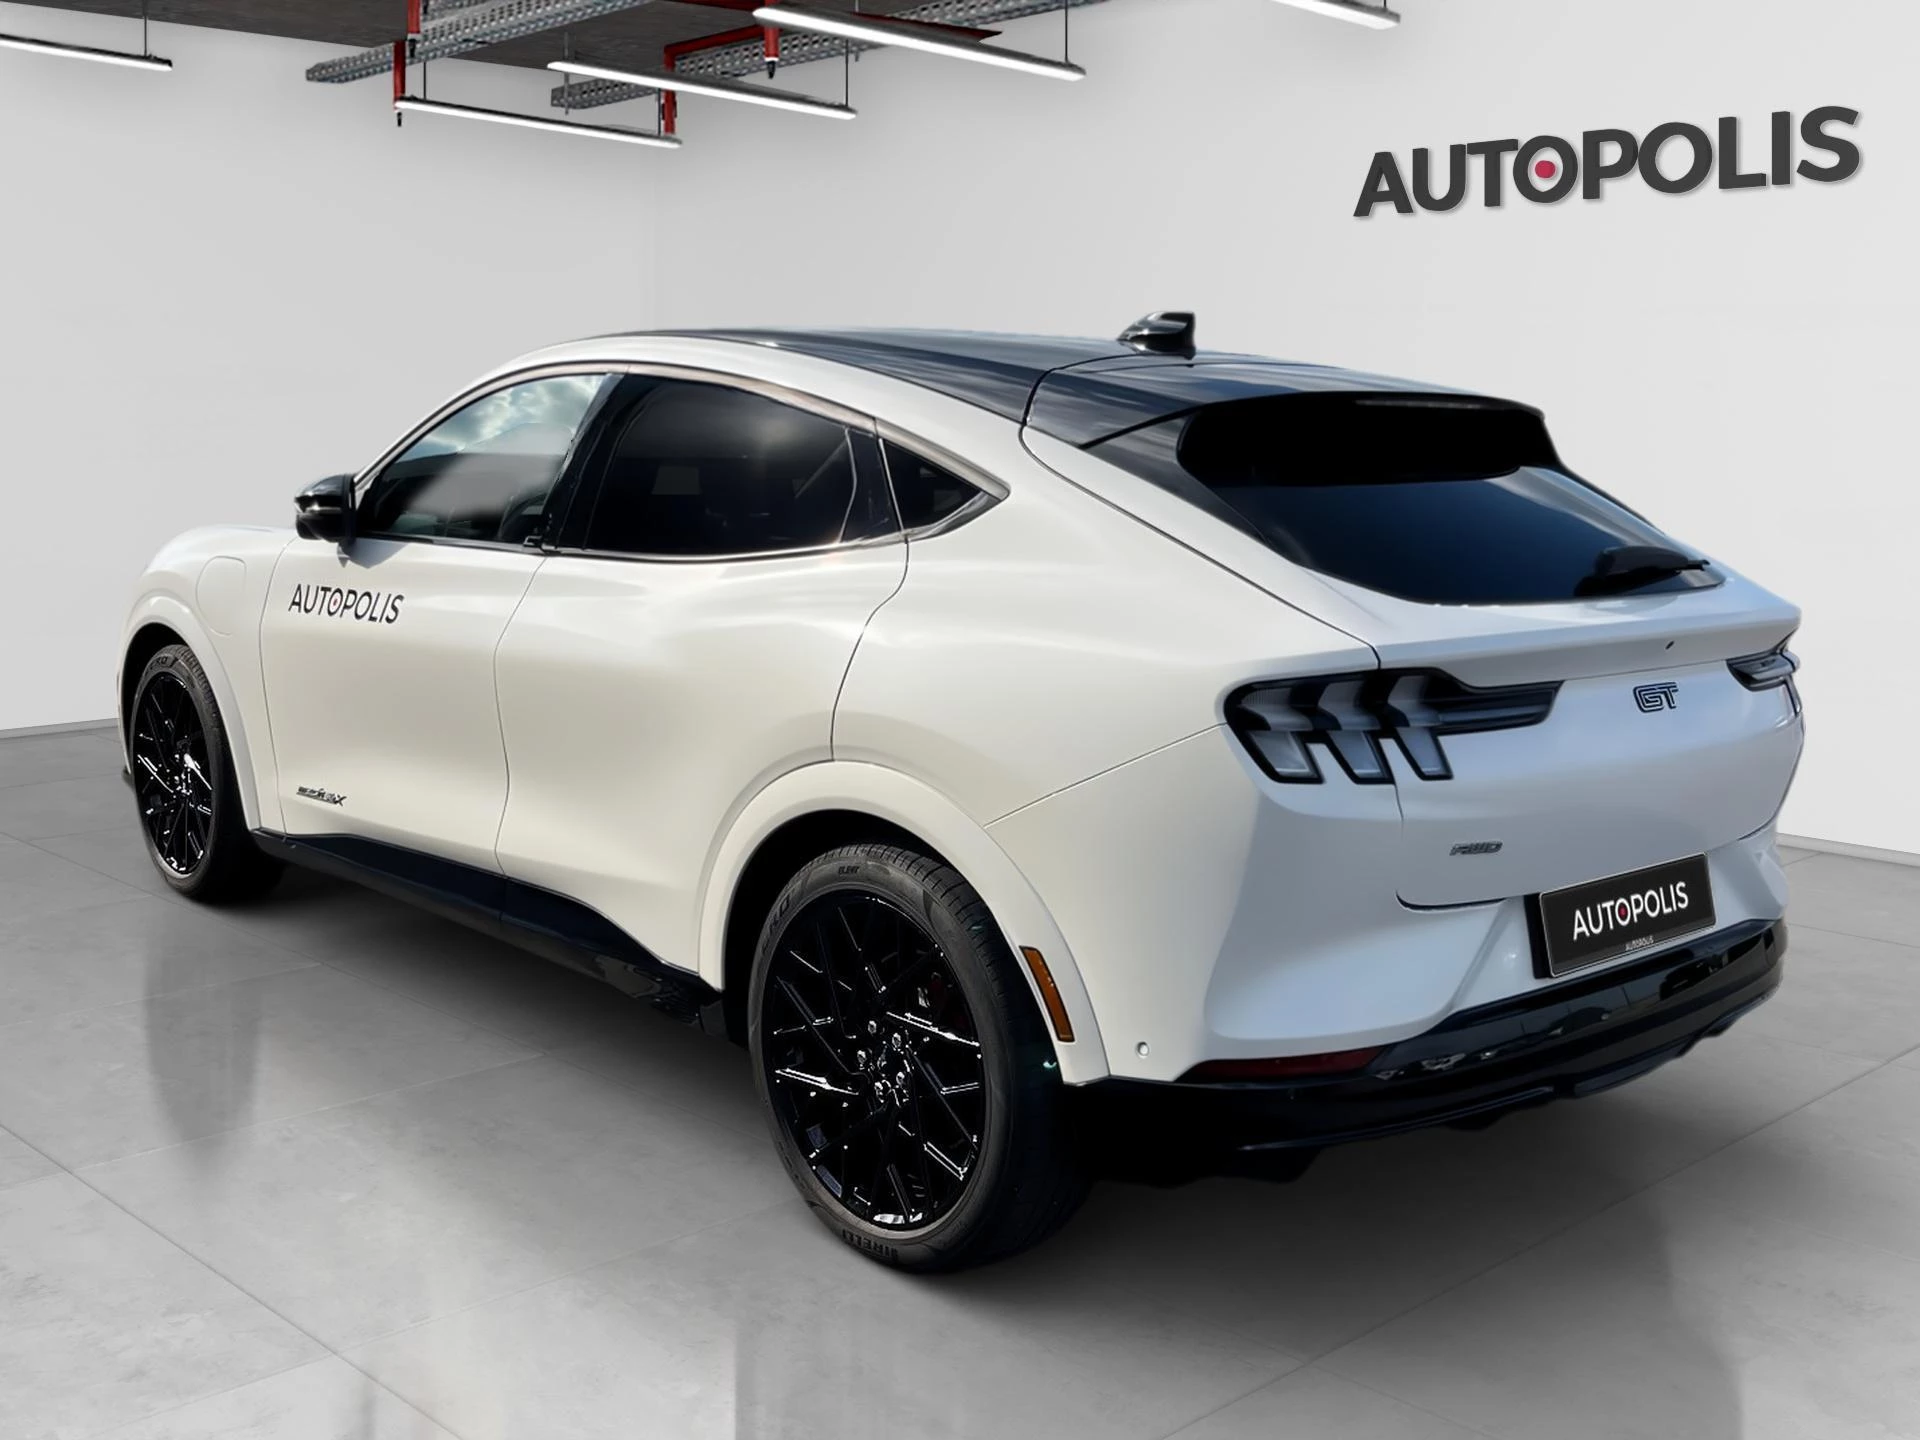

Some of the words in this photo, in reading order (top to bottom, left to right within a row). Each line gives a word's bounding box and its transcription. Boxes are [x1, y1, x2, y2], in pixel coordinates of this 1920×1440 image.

[1353, 105, 1861, 217] AUTOPOLIS
[288, 583, 405, 624] AUTOPOLIS
[1633, 681, 1679, 713] GT
[1572, 881, 1689, 941] AUTOPOLIS
